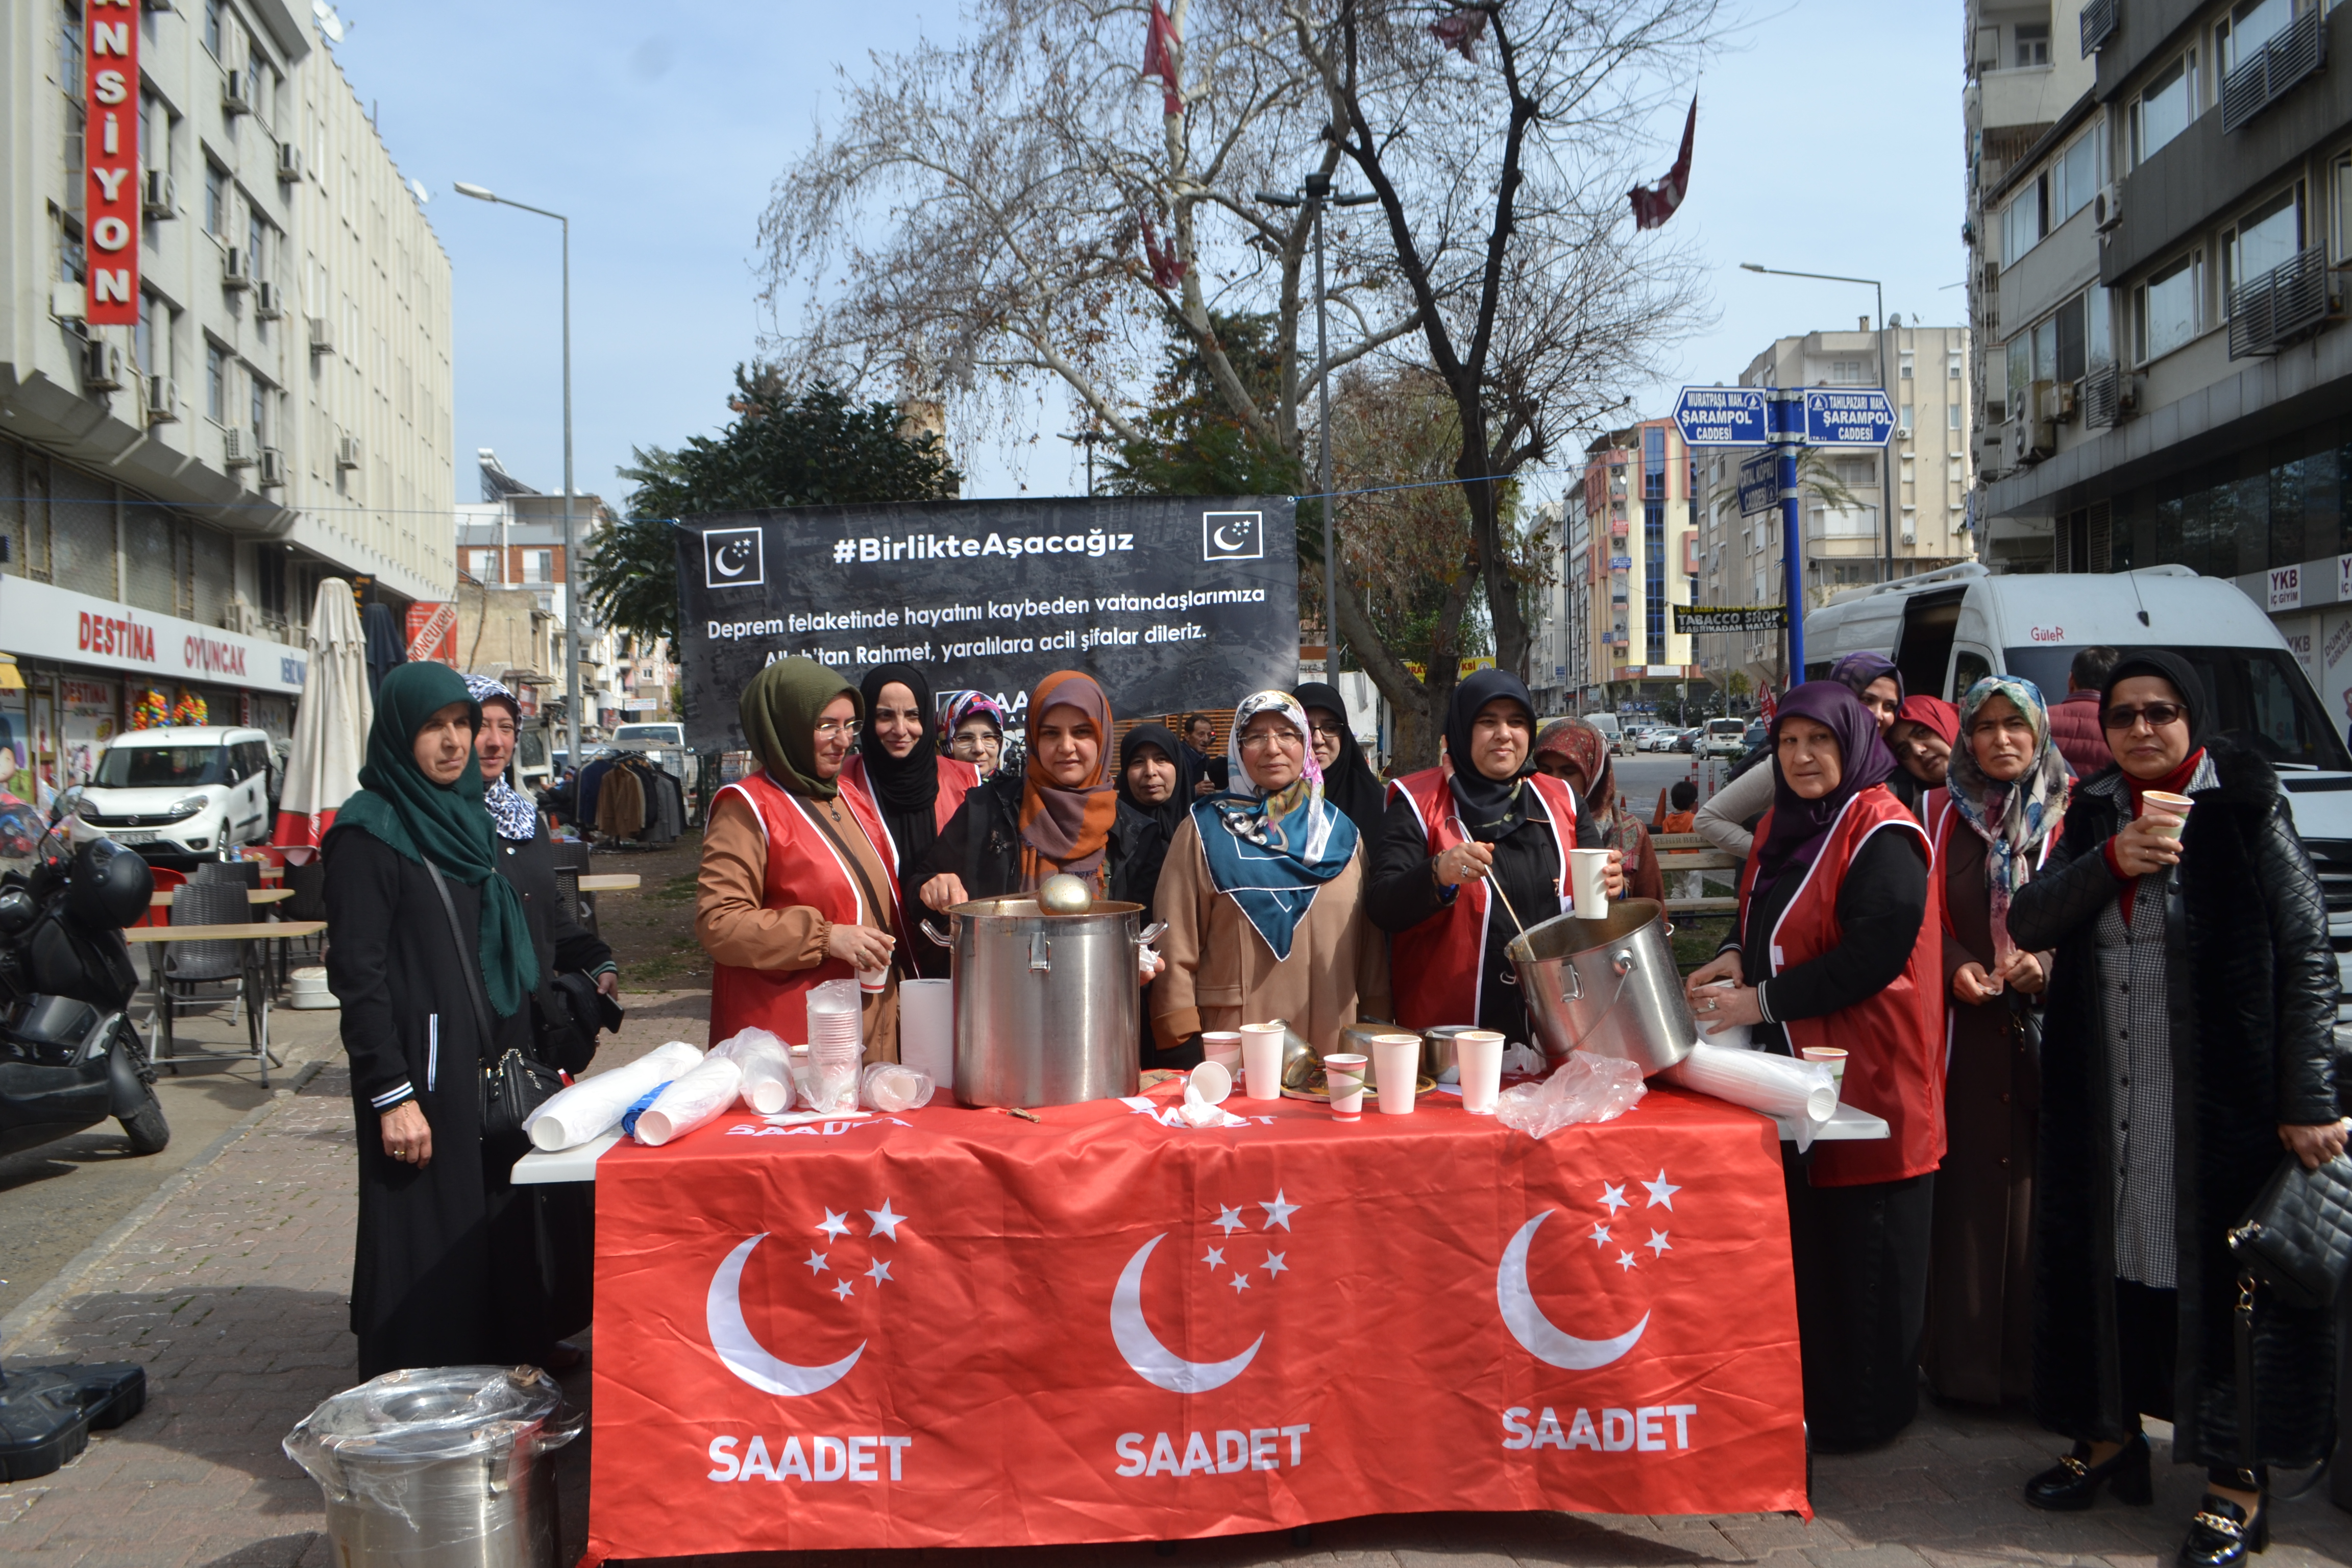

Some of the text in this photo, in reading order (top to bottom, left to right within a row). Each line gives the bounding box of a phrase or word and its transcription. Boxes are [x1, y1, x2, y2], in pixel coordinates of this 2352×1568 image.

[93, 0, 131, 303] NSİYON
[1687, 392, 1727, 410] MURATPAŞA
[1728, 393, 1744, 407] MAH.
[1829, 396, 1868, 410] TAHILPAZARI
[1870, 397, 1885, 410] MAH.
[1681, 409, 1753, 427] ŞARAMPOL
[1823, 410, 1892, 428] ŞARAMPOL
[1696, 424, 1732, 440] CADDESİ
[1838, 425, 1873, 441] CADDESİ
[1740, 456, 1774, 493] ÇATAL KÖPRÜ
[1745, 482, 1767, 511] CADDESİ
[832, 528, 1134, 564] #BirlikteAşacağız
[2271, 569, 2297, 591] YKB
[2271, 590, 2298, 607] İÇ GİYİM
[707, 589, 1265, 642] Deprem felaketinde hayatını kaybeden vatandaşlarımıza
[1677, 610, 1780, 626] TABACCO SHOP
[1746, 621, 1779, 632] HALKA
[79, 611, 155, 663] DESTİNA
[184, 634, 247, 677] OYUNCAK
[856, 641, 936, 664] Rahmet,
[941, 635, 1033, 663] yaralılara
[1039, 630, 1075, 651] acil
[1081, 627, 1139, 651] şifalar
[1144, 622, 1206, 644] dileriz.
[2030, 626, 2065, 642] GüleR
[2324, 619, 2351, 657] DÜNYA
[1502, 1405, 1696, 1451] SAADET
[707, 1435, 912, 1481] SAADET
[1115, 1425, 1310, 1477] SAADET
